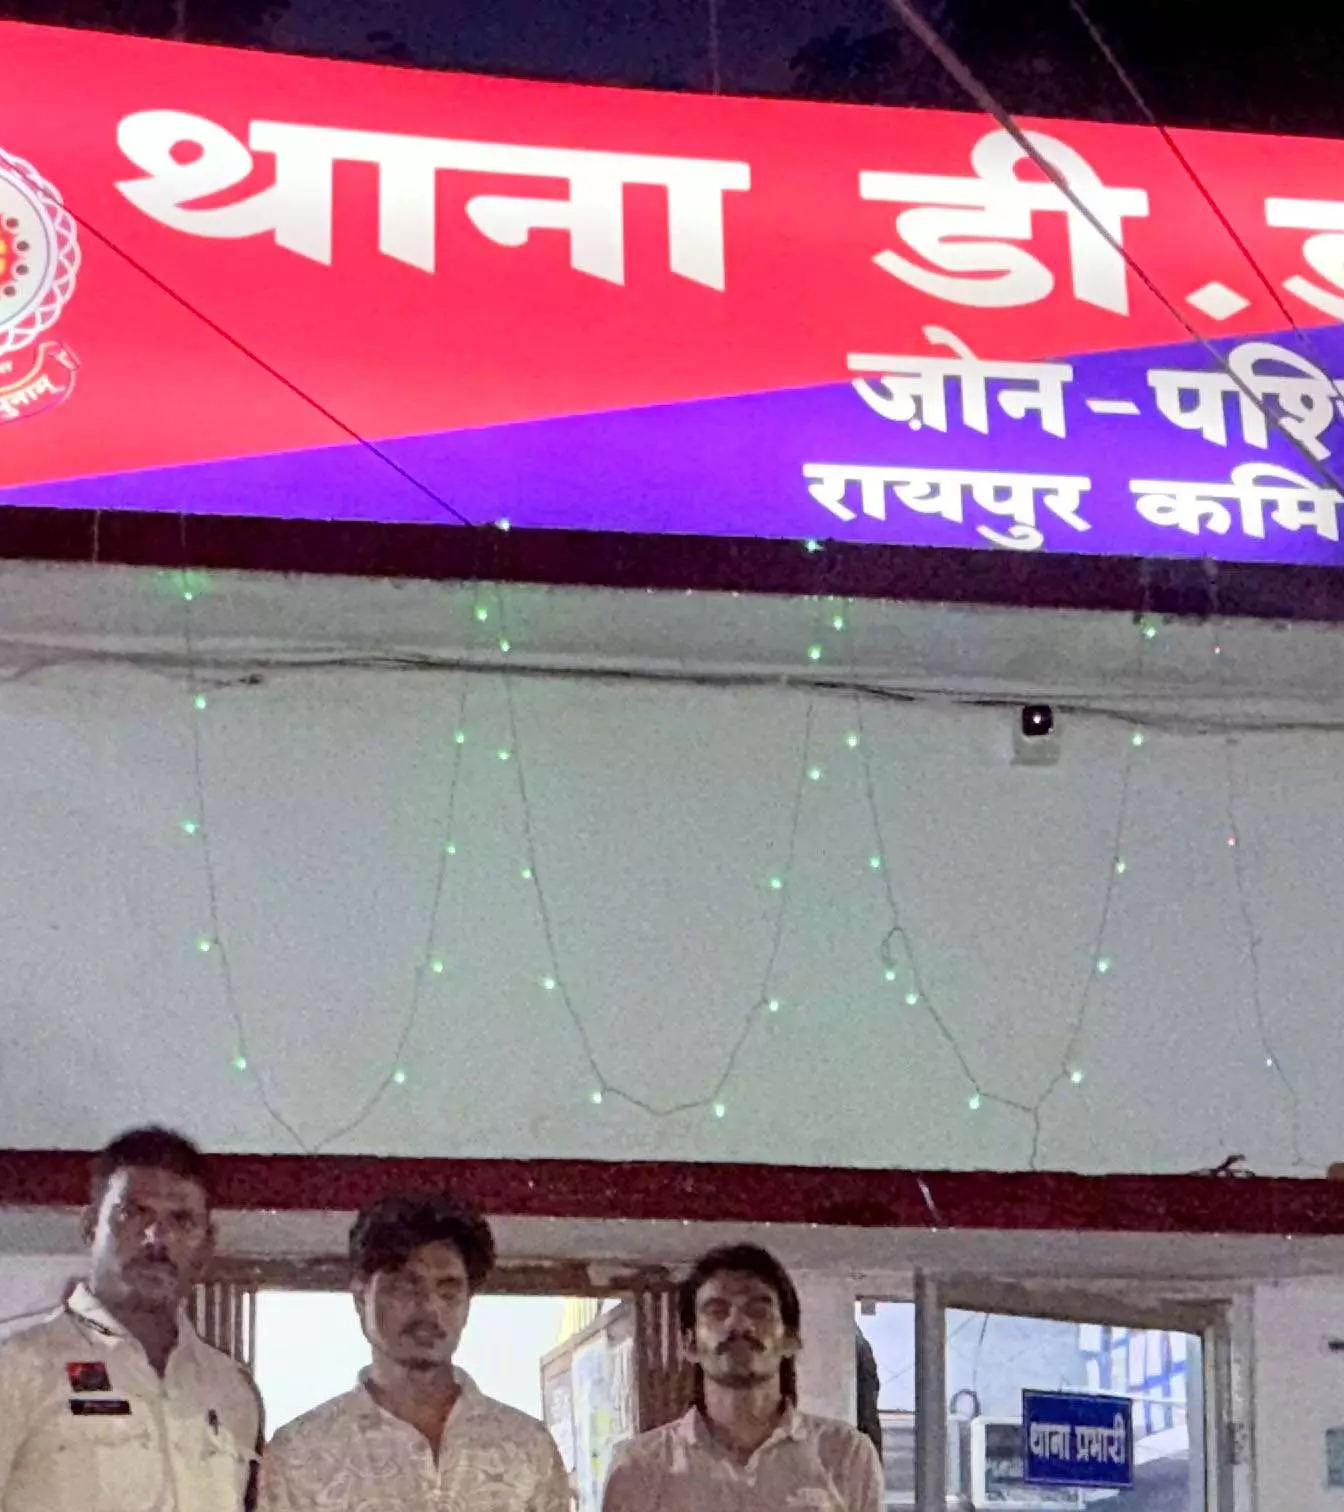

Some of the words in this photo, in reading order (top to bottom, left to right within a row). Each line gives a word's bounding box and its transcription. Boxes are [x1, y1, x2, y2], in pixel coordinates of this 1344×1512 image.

[115, 109, 751, 291] थाना
[802, 463, 1092, 551] रायपुर
[1030, 1421, 1071, 1461] थाना
[1074, 1413, 1126, 1464] प्रभारी
